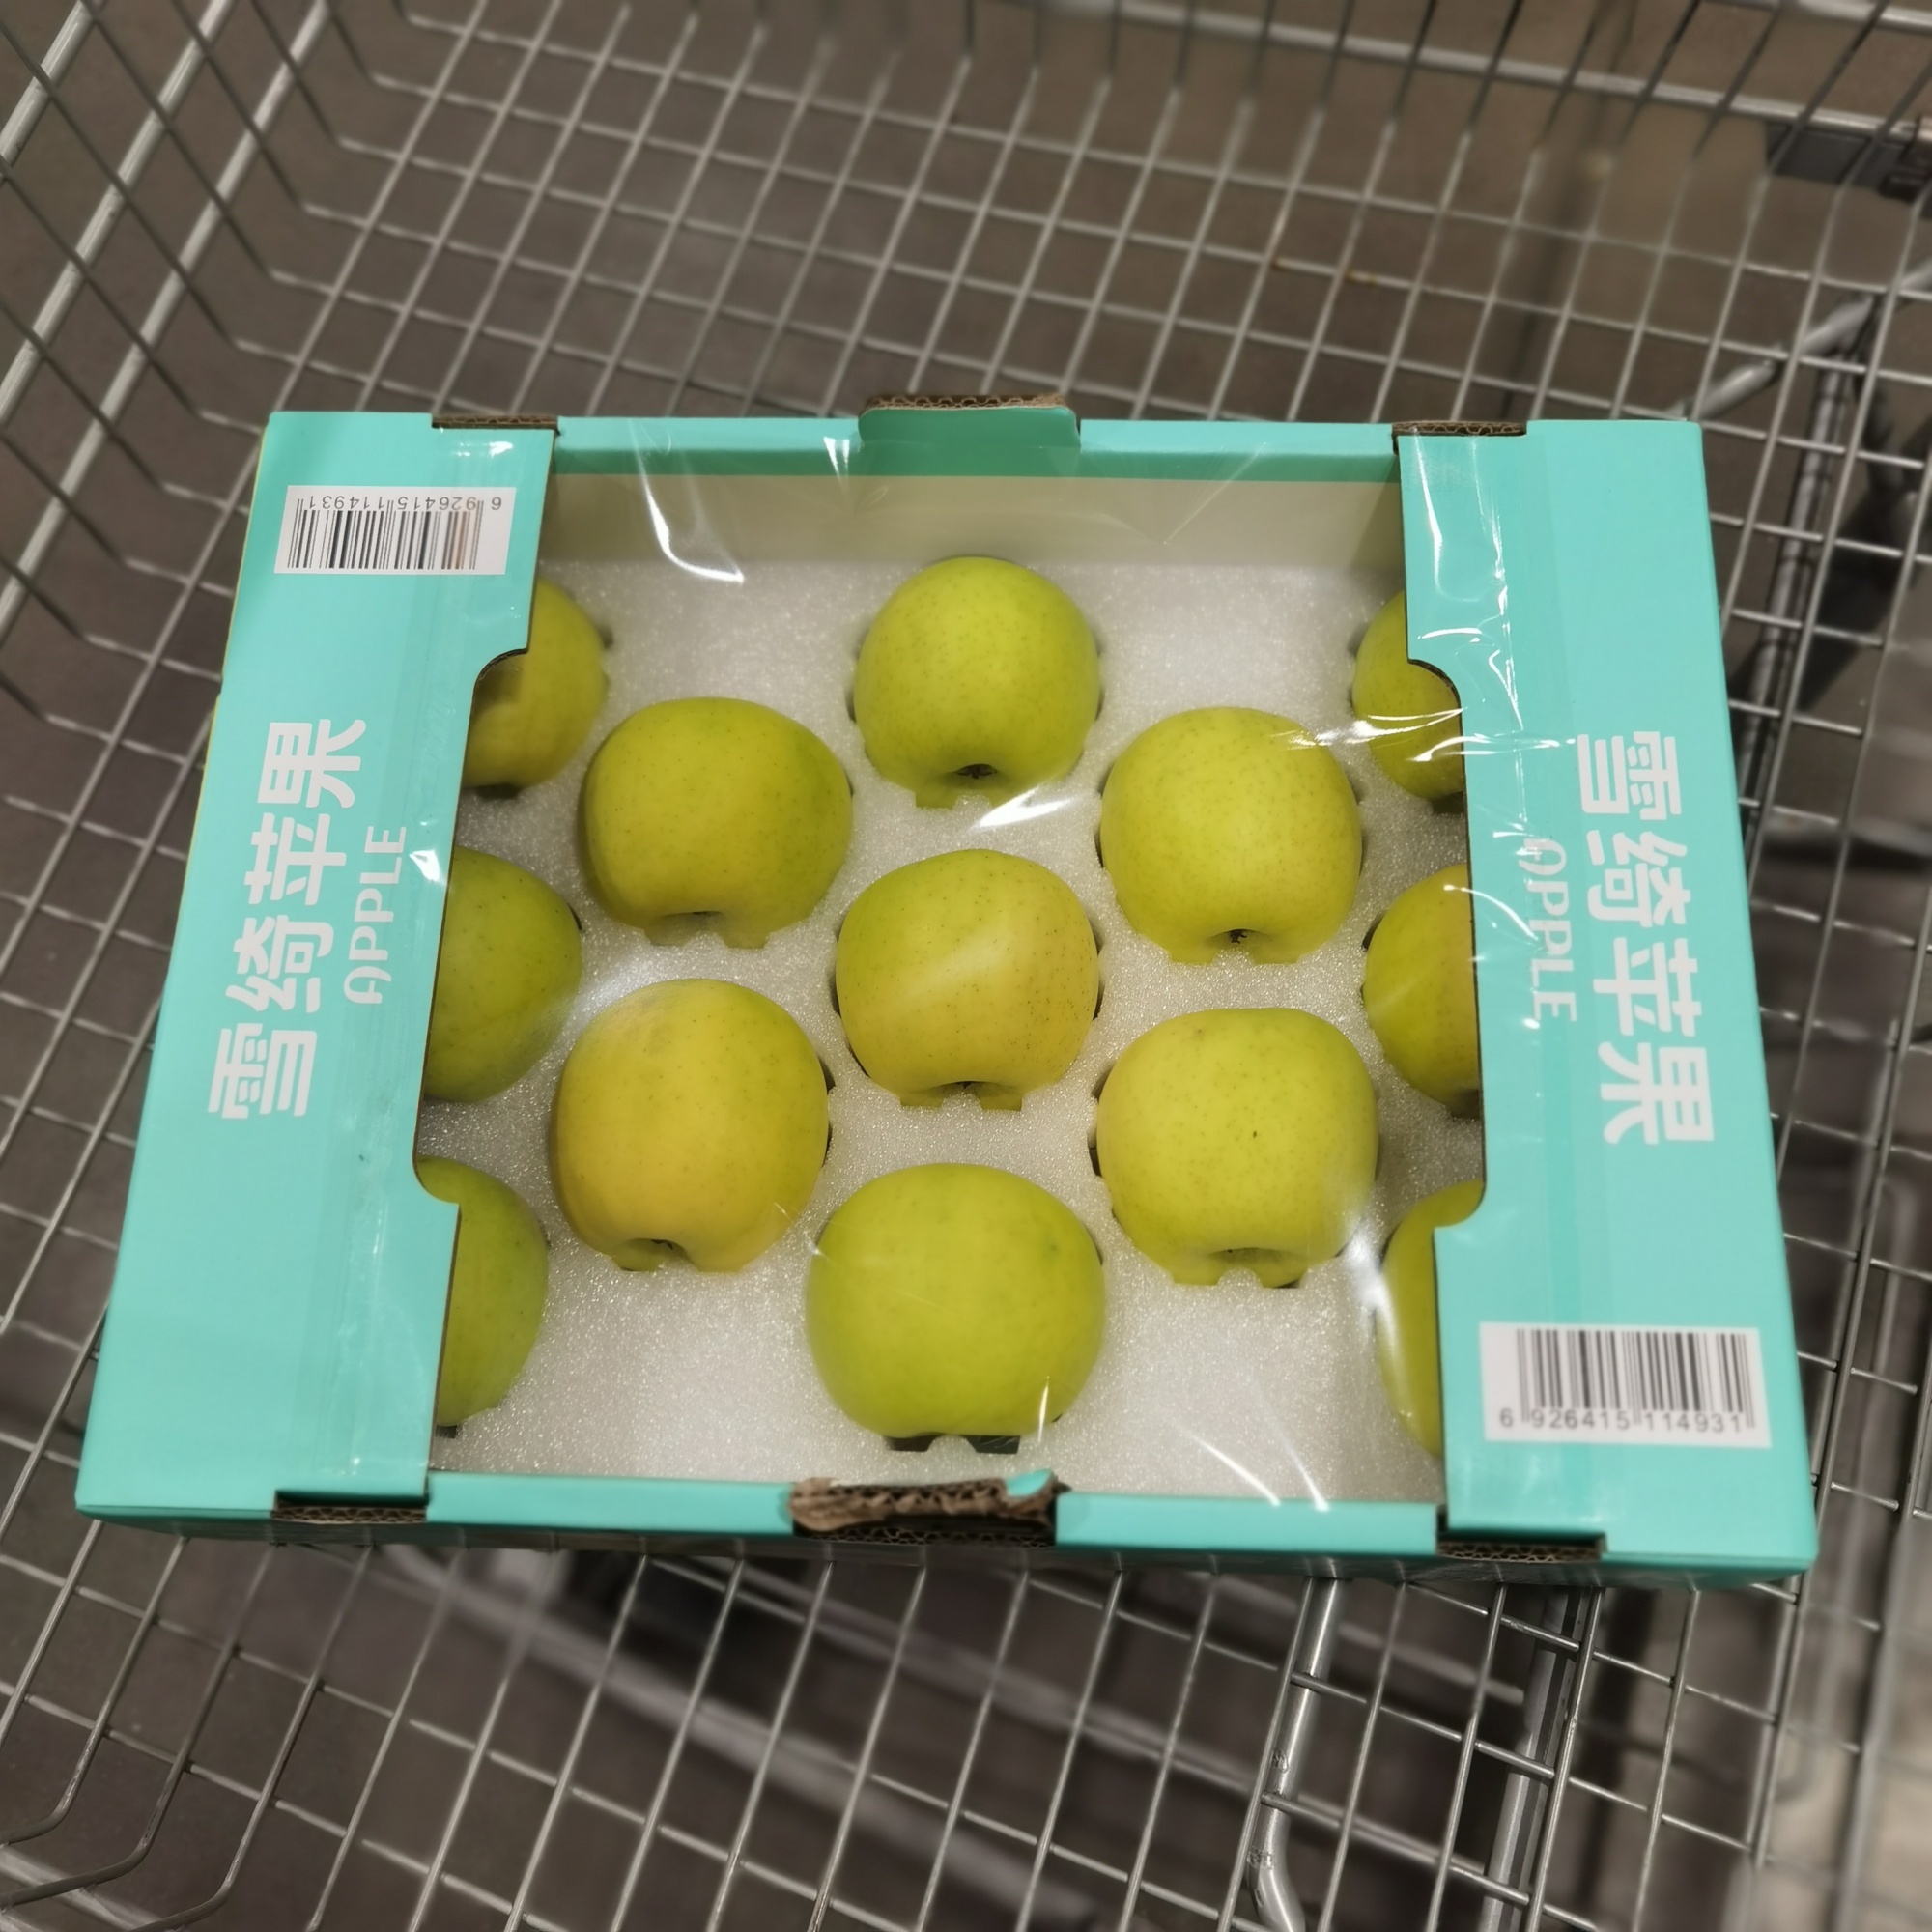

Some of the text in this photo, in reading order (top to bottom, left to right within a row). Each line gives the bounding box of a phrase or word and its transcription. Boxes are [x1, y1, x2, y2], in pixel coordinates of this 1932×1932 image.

[308, 495, 503, 511] 6 926415 114931
[207, 718, 367, 1121] 雪绮苹果
[343, 825, 407, 1005] APPLE
[1518, 838, 1577, 1023] APPLE
[1577, 730, 1715, 1146] 雪绮苹果
[1499, 1407, 1741, 1434] 6 926415 114931
